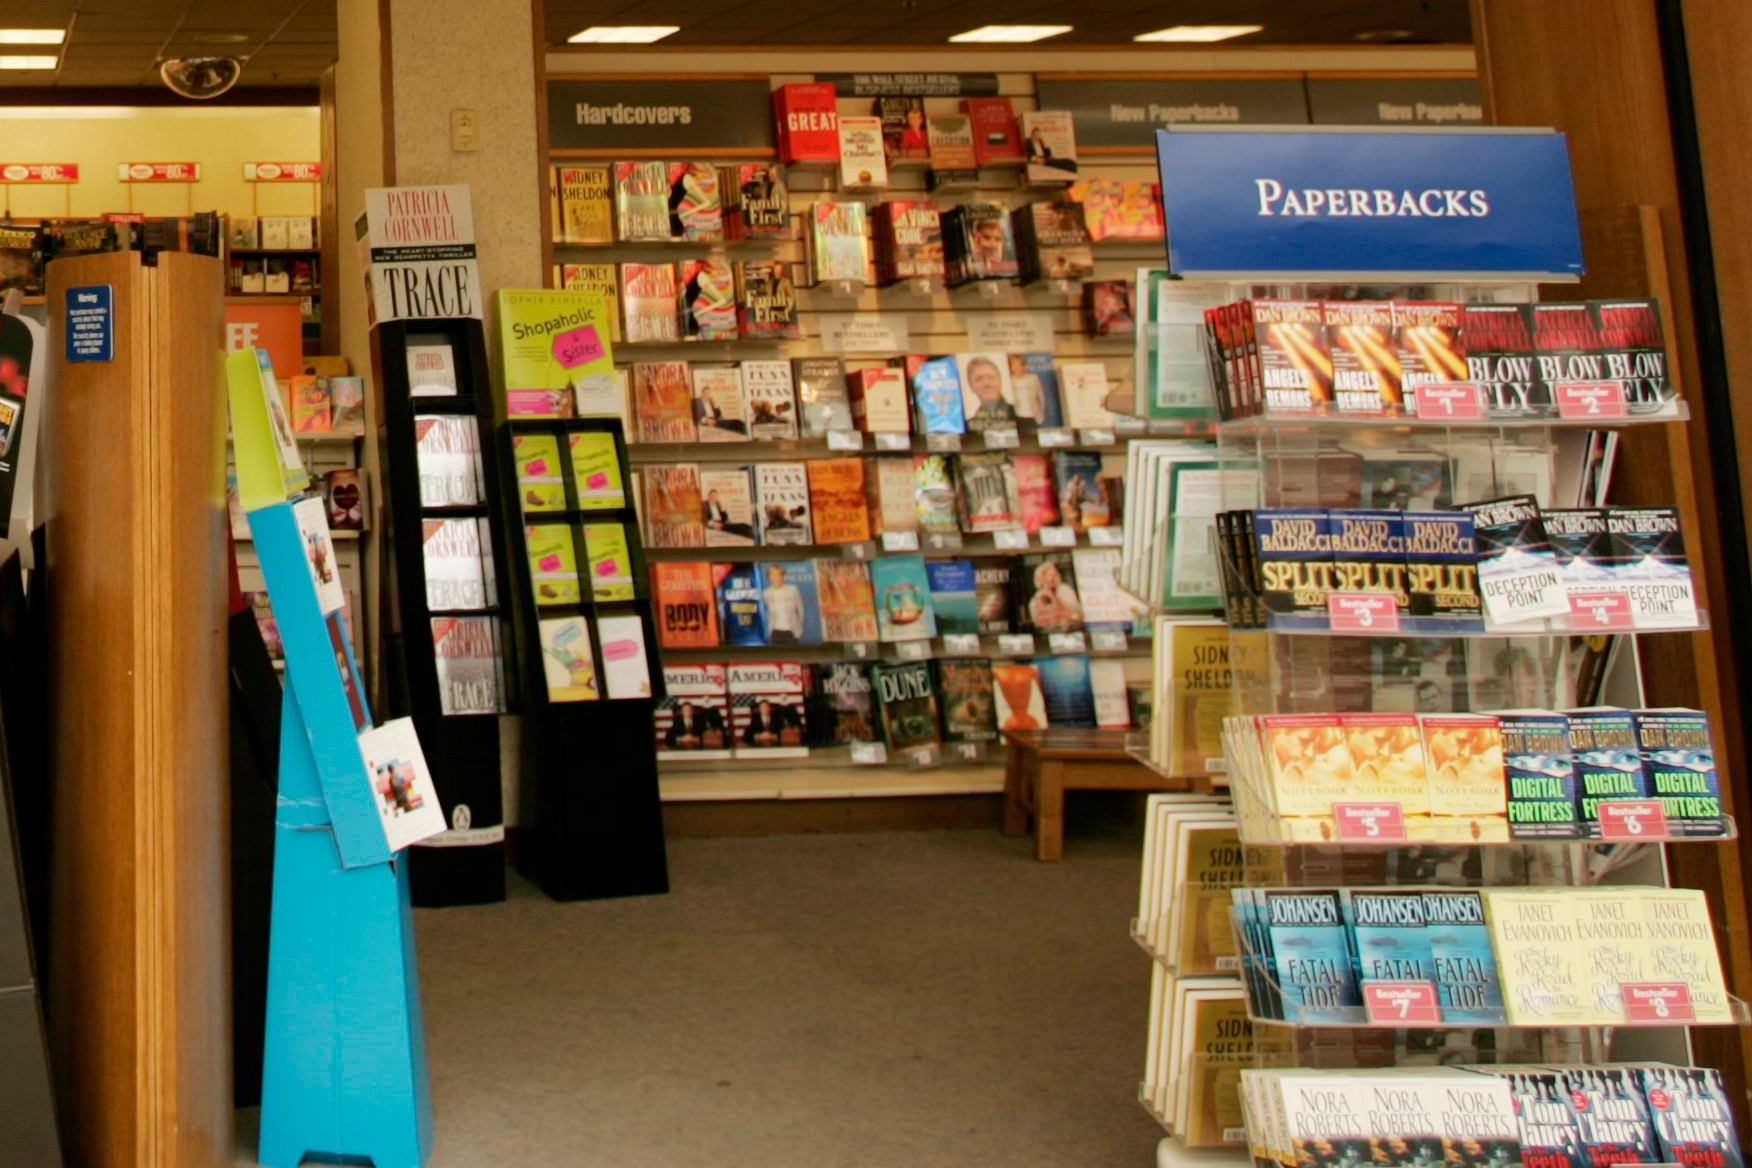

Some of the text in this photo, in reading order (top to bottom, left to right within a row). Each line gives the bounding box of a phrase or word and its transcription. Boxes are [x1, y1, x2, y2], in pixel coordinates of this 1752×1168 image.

[576, 103, 692, 126] Hardcovers
[787, 112, 837, 132] GREAT
[1111, 103, 1240, 123] New Paperbacks
[387, 190, 451, 216] PATRICIA
[563, 186, 610, 201] SHELDON
[1255, 179, 1490, 218] PAPERBACKS
[751, 208, 785, 225] First
[384, 216, 459, 242] CORNWELL
[383, 265, 472, 318] TRACE
[504, 295, 602, 305] SOPHIE KINSELLA
[512, 307, 596, 340] Shopaholic
[1256, 309, 1321, 323] DAN BROWN
[1326, 311, 1391, 326] DAN BROWN
[562, 343, 598, 364] Sister
[1264, 368, 1311, 388] ANGELS
[1465, 357, 1534, 382] BLOW
[1537, 355, 1602, 381] BLOW
[1266, 389, 1312, 409] DEMONS
[1424, 388, 1467, 399] Bestseller
[1479, 382, 1534, 411] FLY
[1566, 388, 1610, 398] Bestseller
[1271, 519, 1316, 536] DAVID
[1342, 520, 1389, 537] DAVID
[1608, 517, 1678, 533] DAN BROWN
[1261, 534, 1331, 552] BALDACCI
[1262, 562, 1334, 592] SPLIT
[1335, 562, 1408, 593] SPLIT
[1485, 573, 1557, 597] DECEPTION
[1340, 598, 1385, 609] Bestseller
[1435, 593, 1480, 608] SECOND
[1507, 588, 1545, 609] POINT
[1577, 597, 1618, 607] Bestseller
[1640, 601, 1676, 614] POINT
[880, 670, 930, 703] DUNE
[1640, 729, 1709, 748] DAN BROWN
[1355, 785, 1424, 795] NOTEBOOK
[1434, 784, 1500, 795] NOTEBOOK
[1511, 777, 1565, 798] DIGITAL
[1655, 772, 1710, 793] DIGITAL
[1345, 807, 1390, 818] Bestseller
[1508, 800, 1574, 822] FORTRESS
[1608, 806, 1652, 816] Bestseller
[1272, 898, 1337, 923] JOHANSEN
[1357, 898, 1423, 924] JOHANSEN
[1518, 903, 1555, 921] JANET
[1503, 920, 1572, 942] EVANOVICH
[1289, 959, 1345, 984] FATAL
[1435, 957, 1492, 983] FATAL
[1300, 984, 1345, 1011] TIDE
[1376, 988, 1422, 1000] Bestseller
[1448, 984, 1493, 1011] TIDE
[1633, 988, 1677, 999] Bestseller
[1300, 1087, 1351, 1113] NORA
[1373, 1087, 1424, 1112] NORA
[1518, 1093, 1570, 1125] Tom
[1586, 1090, 1640, 1122] Tom
[1668, 1089, 1722, 1122] Tom
[1295, 1111, 1362, 1137] ROBERTS
[1368, 1110, 1435, 1136] ROBERTS
[1519, 1116, 1579, 1147] lancy
[1576, 1112, 1647, 1144] Clancy
[1656, 1110, 1730, 1143] Clancy
[1588, 1146, 1641, 1167] Teeth
[1669, 1145, 1726, 1168] Teeth
